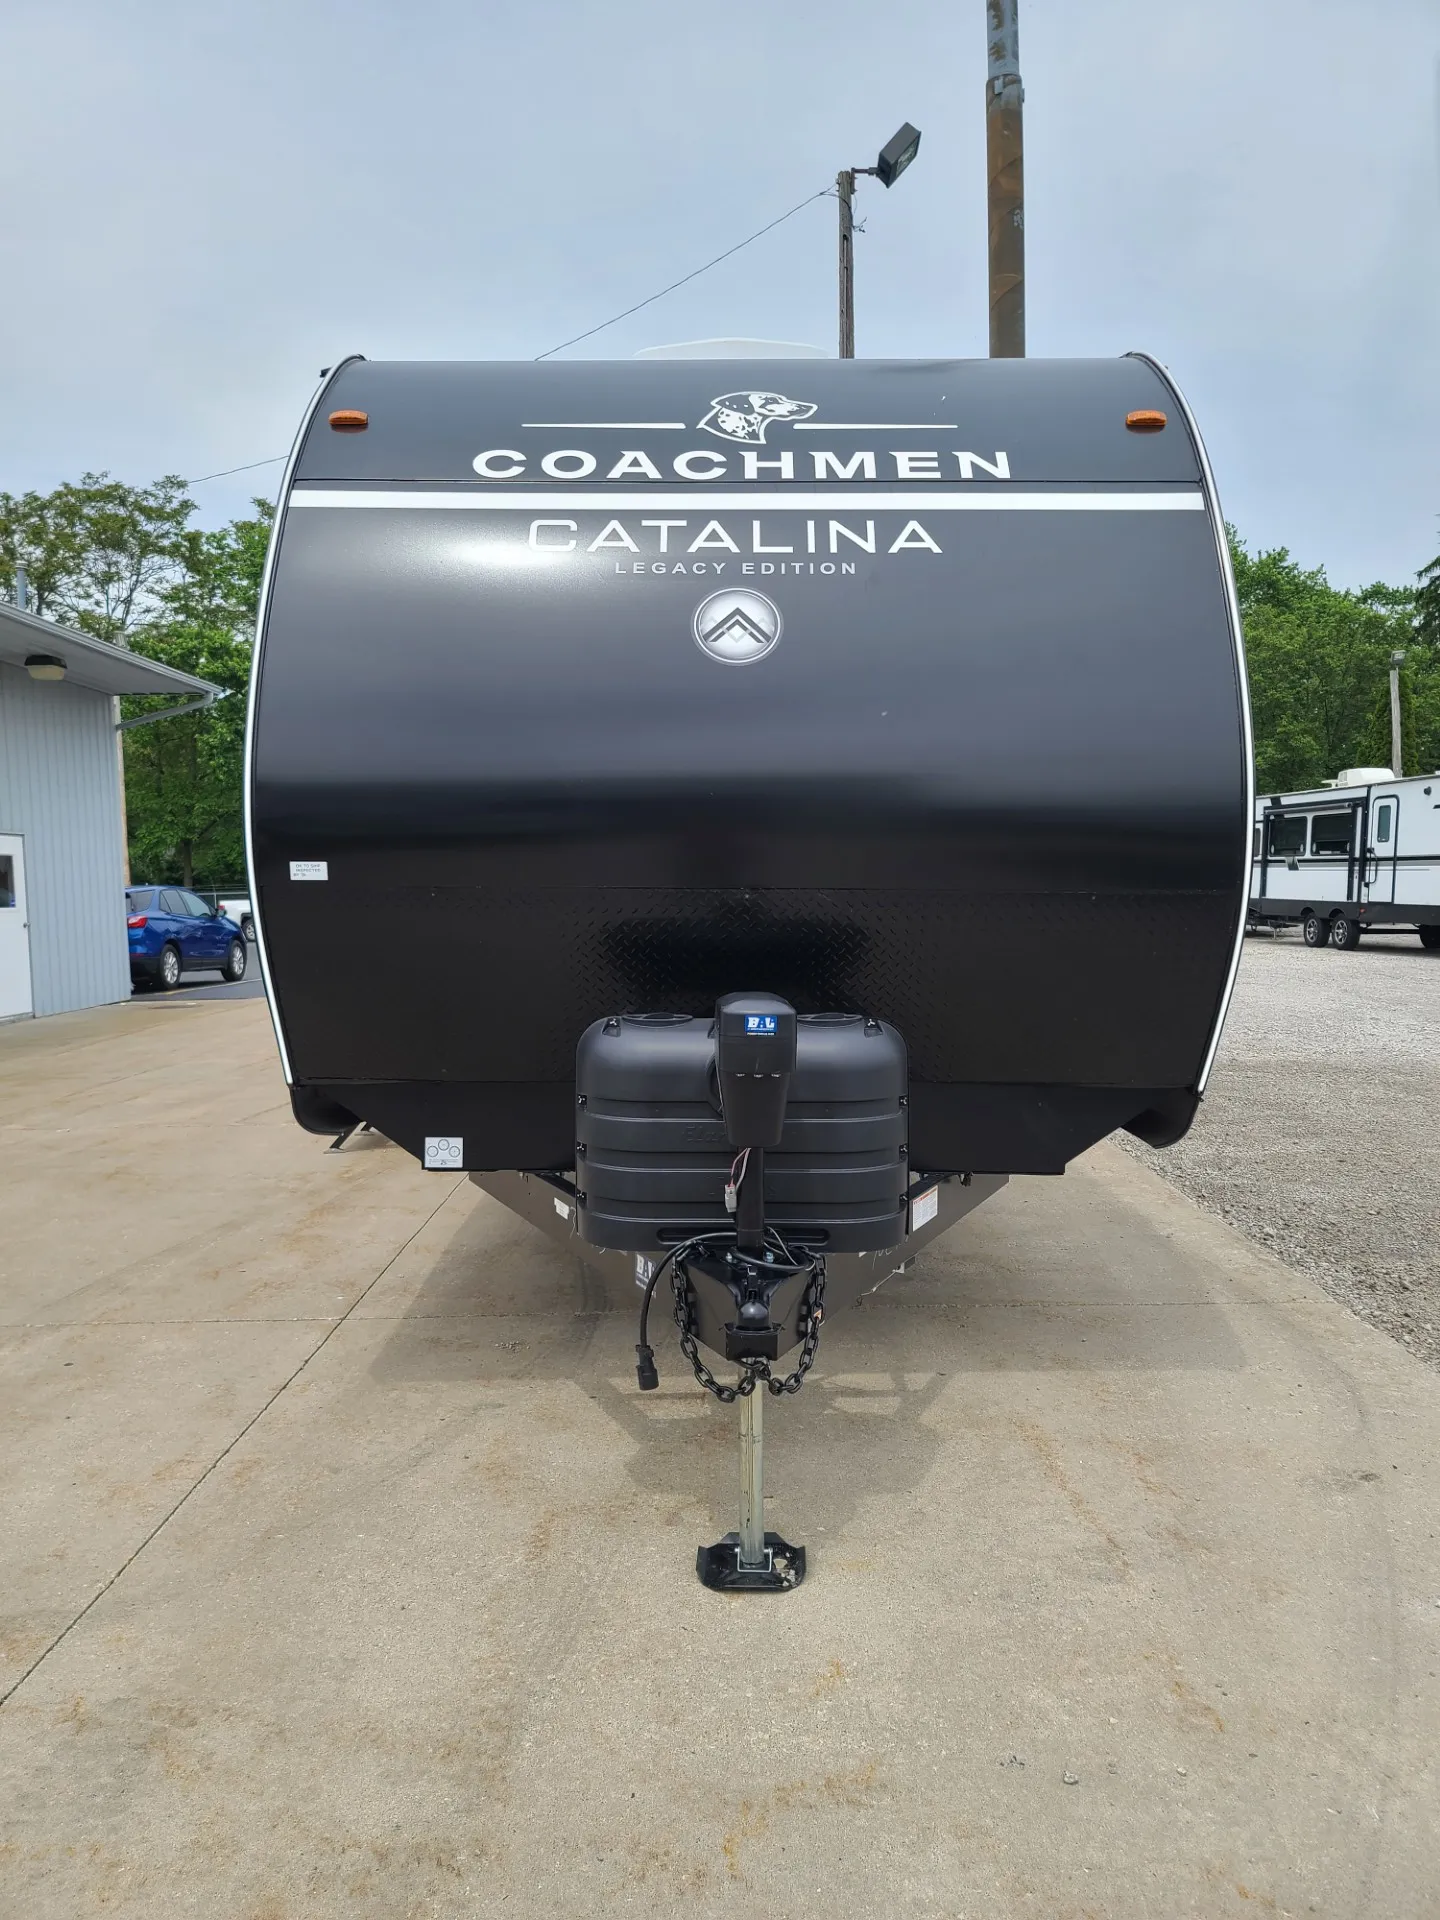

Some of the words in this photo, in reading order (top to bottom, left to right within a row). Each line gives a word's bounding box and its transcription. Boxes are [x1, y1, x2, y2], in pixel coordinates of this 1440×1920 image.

[472, 449, 1011, 480] COACHMEN
[528, 520, 943, 554] CATALINA
[615, 562, 726, 575] LEGACY
[742, 562, 857, 575] EDITION
